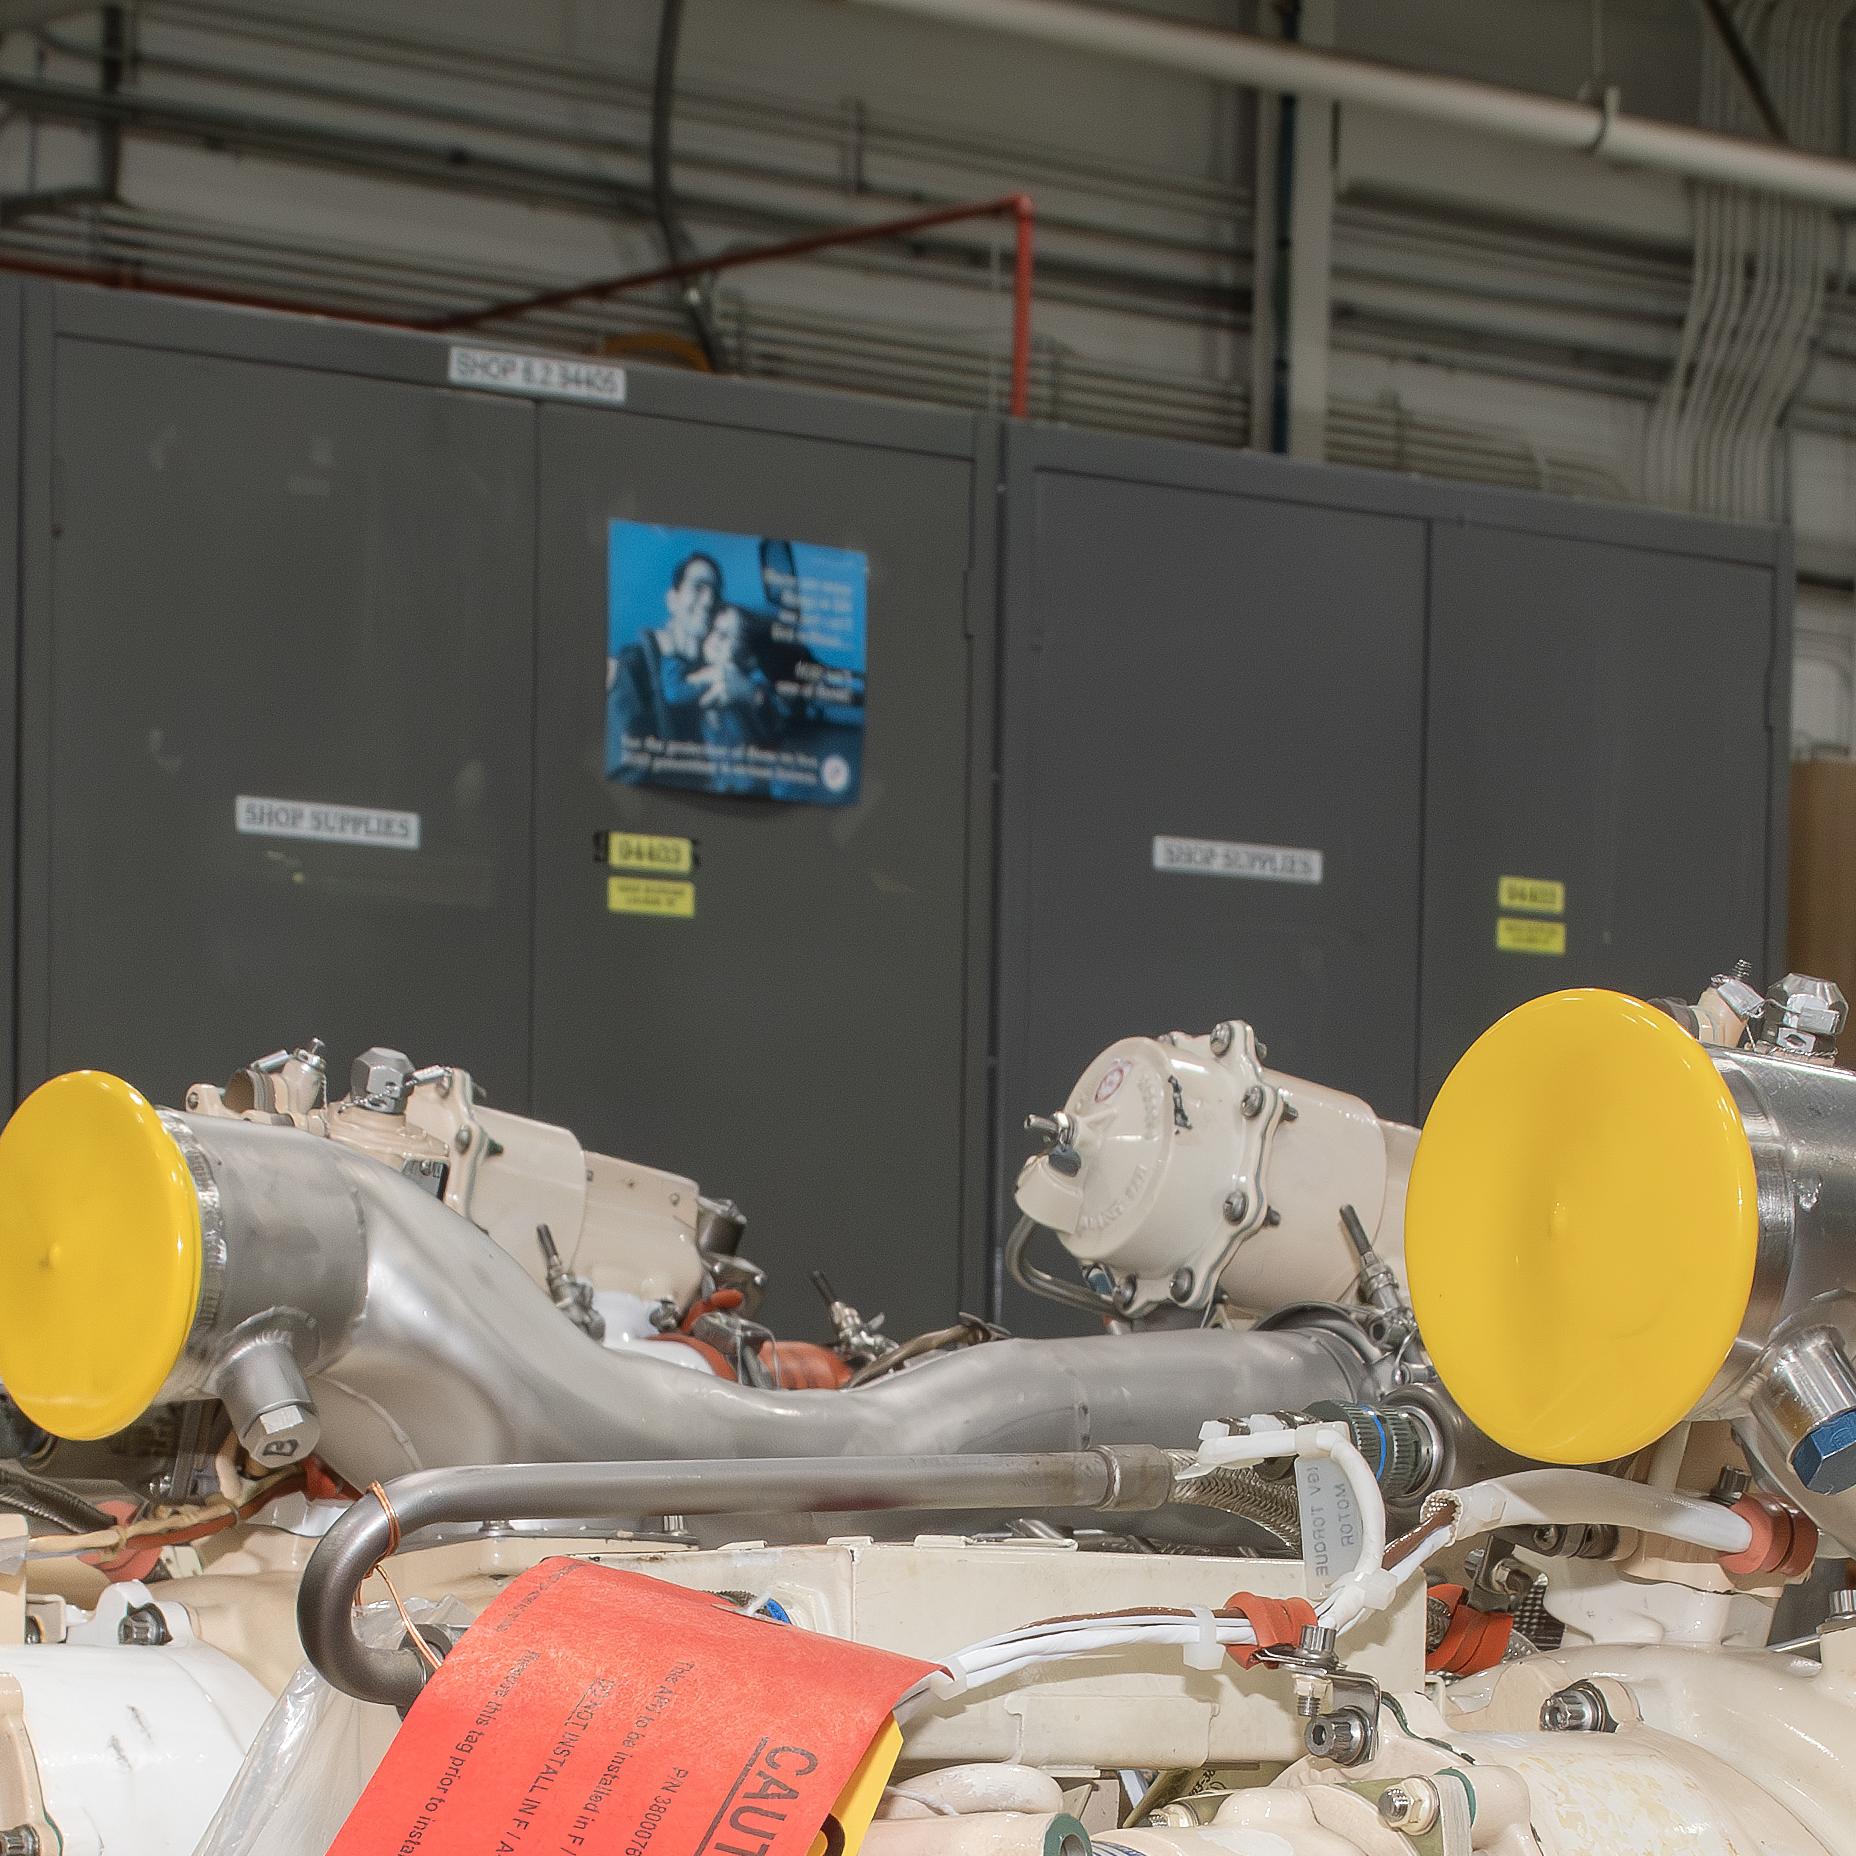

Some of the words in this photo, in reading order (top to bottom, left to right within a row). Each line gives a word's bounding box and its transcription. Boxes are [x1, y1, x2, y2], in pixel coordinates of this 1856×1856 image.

[474, 1700, 503, 1727] this
[455, 1729, 485, 1753] tag
[621, 1730, 646, 1749] be
[436, 1755, 467, 1794] prior
[527, 1732, 581, 1793] INSTALL
[581, 1751, 633, 1816] installed
[424, 1795, 446, 1813] to
[518, 1798, 542, 1818] IN
[573, 1814, 596, 1832] in
